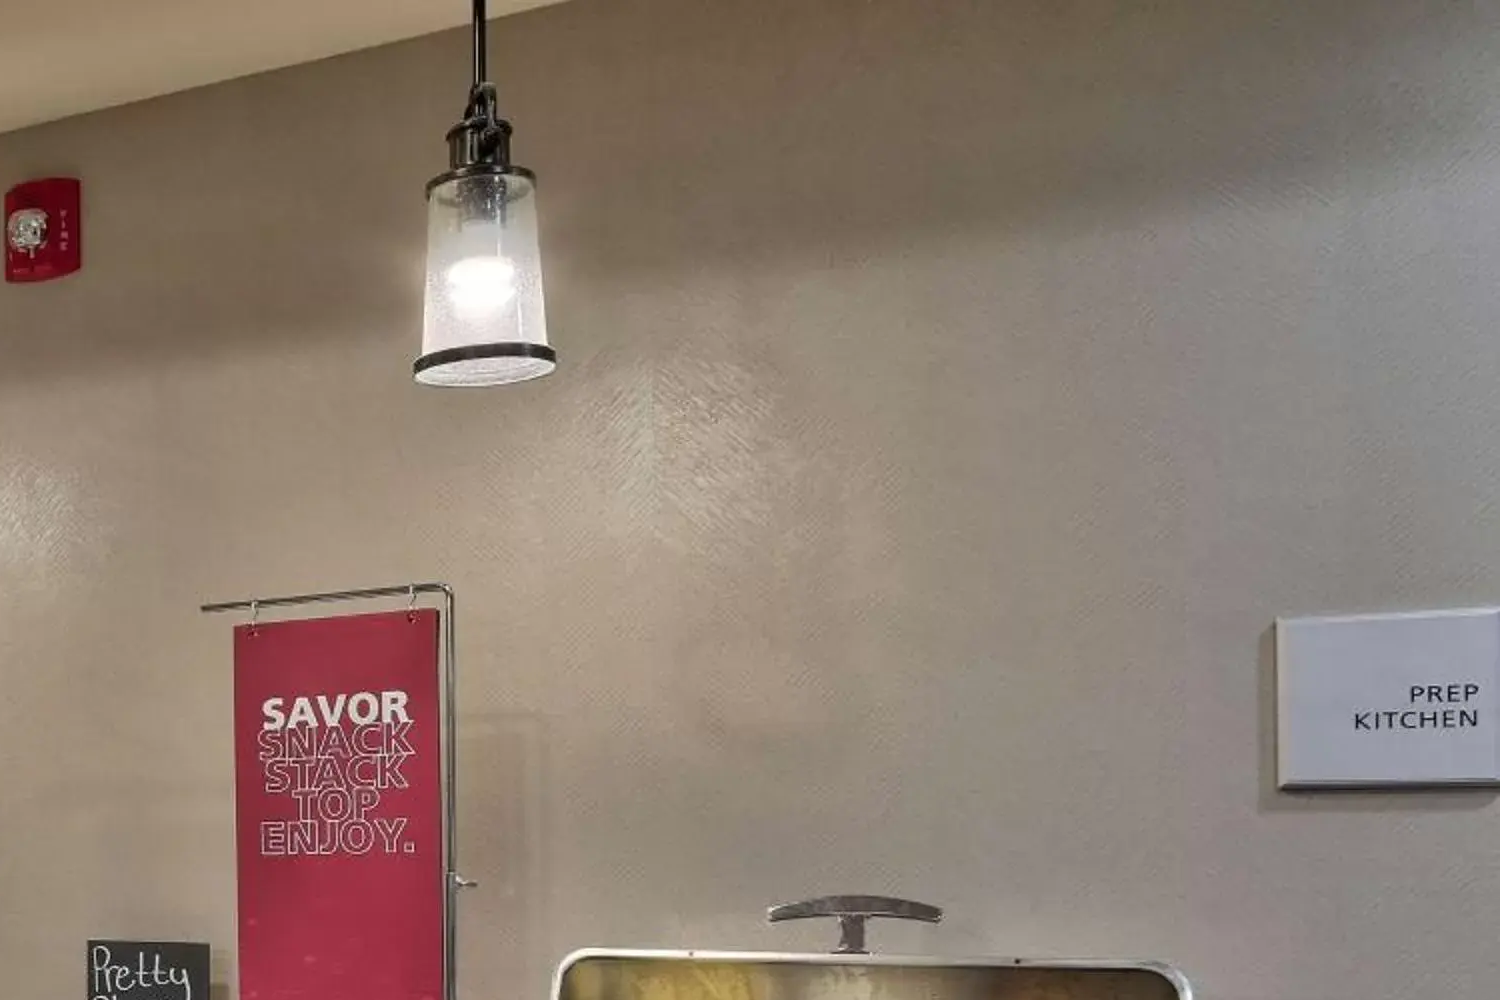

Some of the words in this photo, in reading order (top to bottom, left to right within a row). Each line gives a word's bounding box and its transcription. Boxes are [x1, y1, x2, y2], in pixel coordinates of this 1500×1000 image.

[262, 691, 410, 730] SAVOR
[1410, 683, 1480, 704] PREP
[1354, 709, 1479, 730] KITCHEN
[258, 720, 416, 761] SNACK
[265, 753, 409, 793] STACK
[292, 786, 380, 823] TOP
[260, 817, 415, 855] ENJOY.
